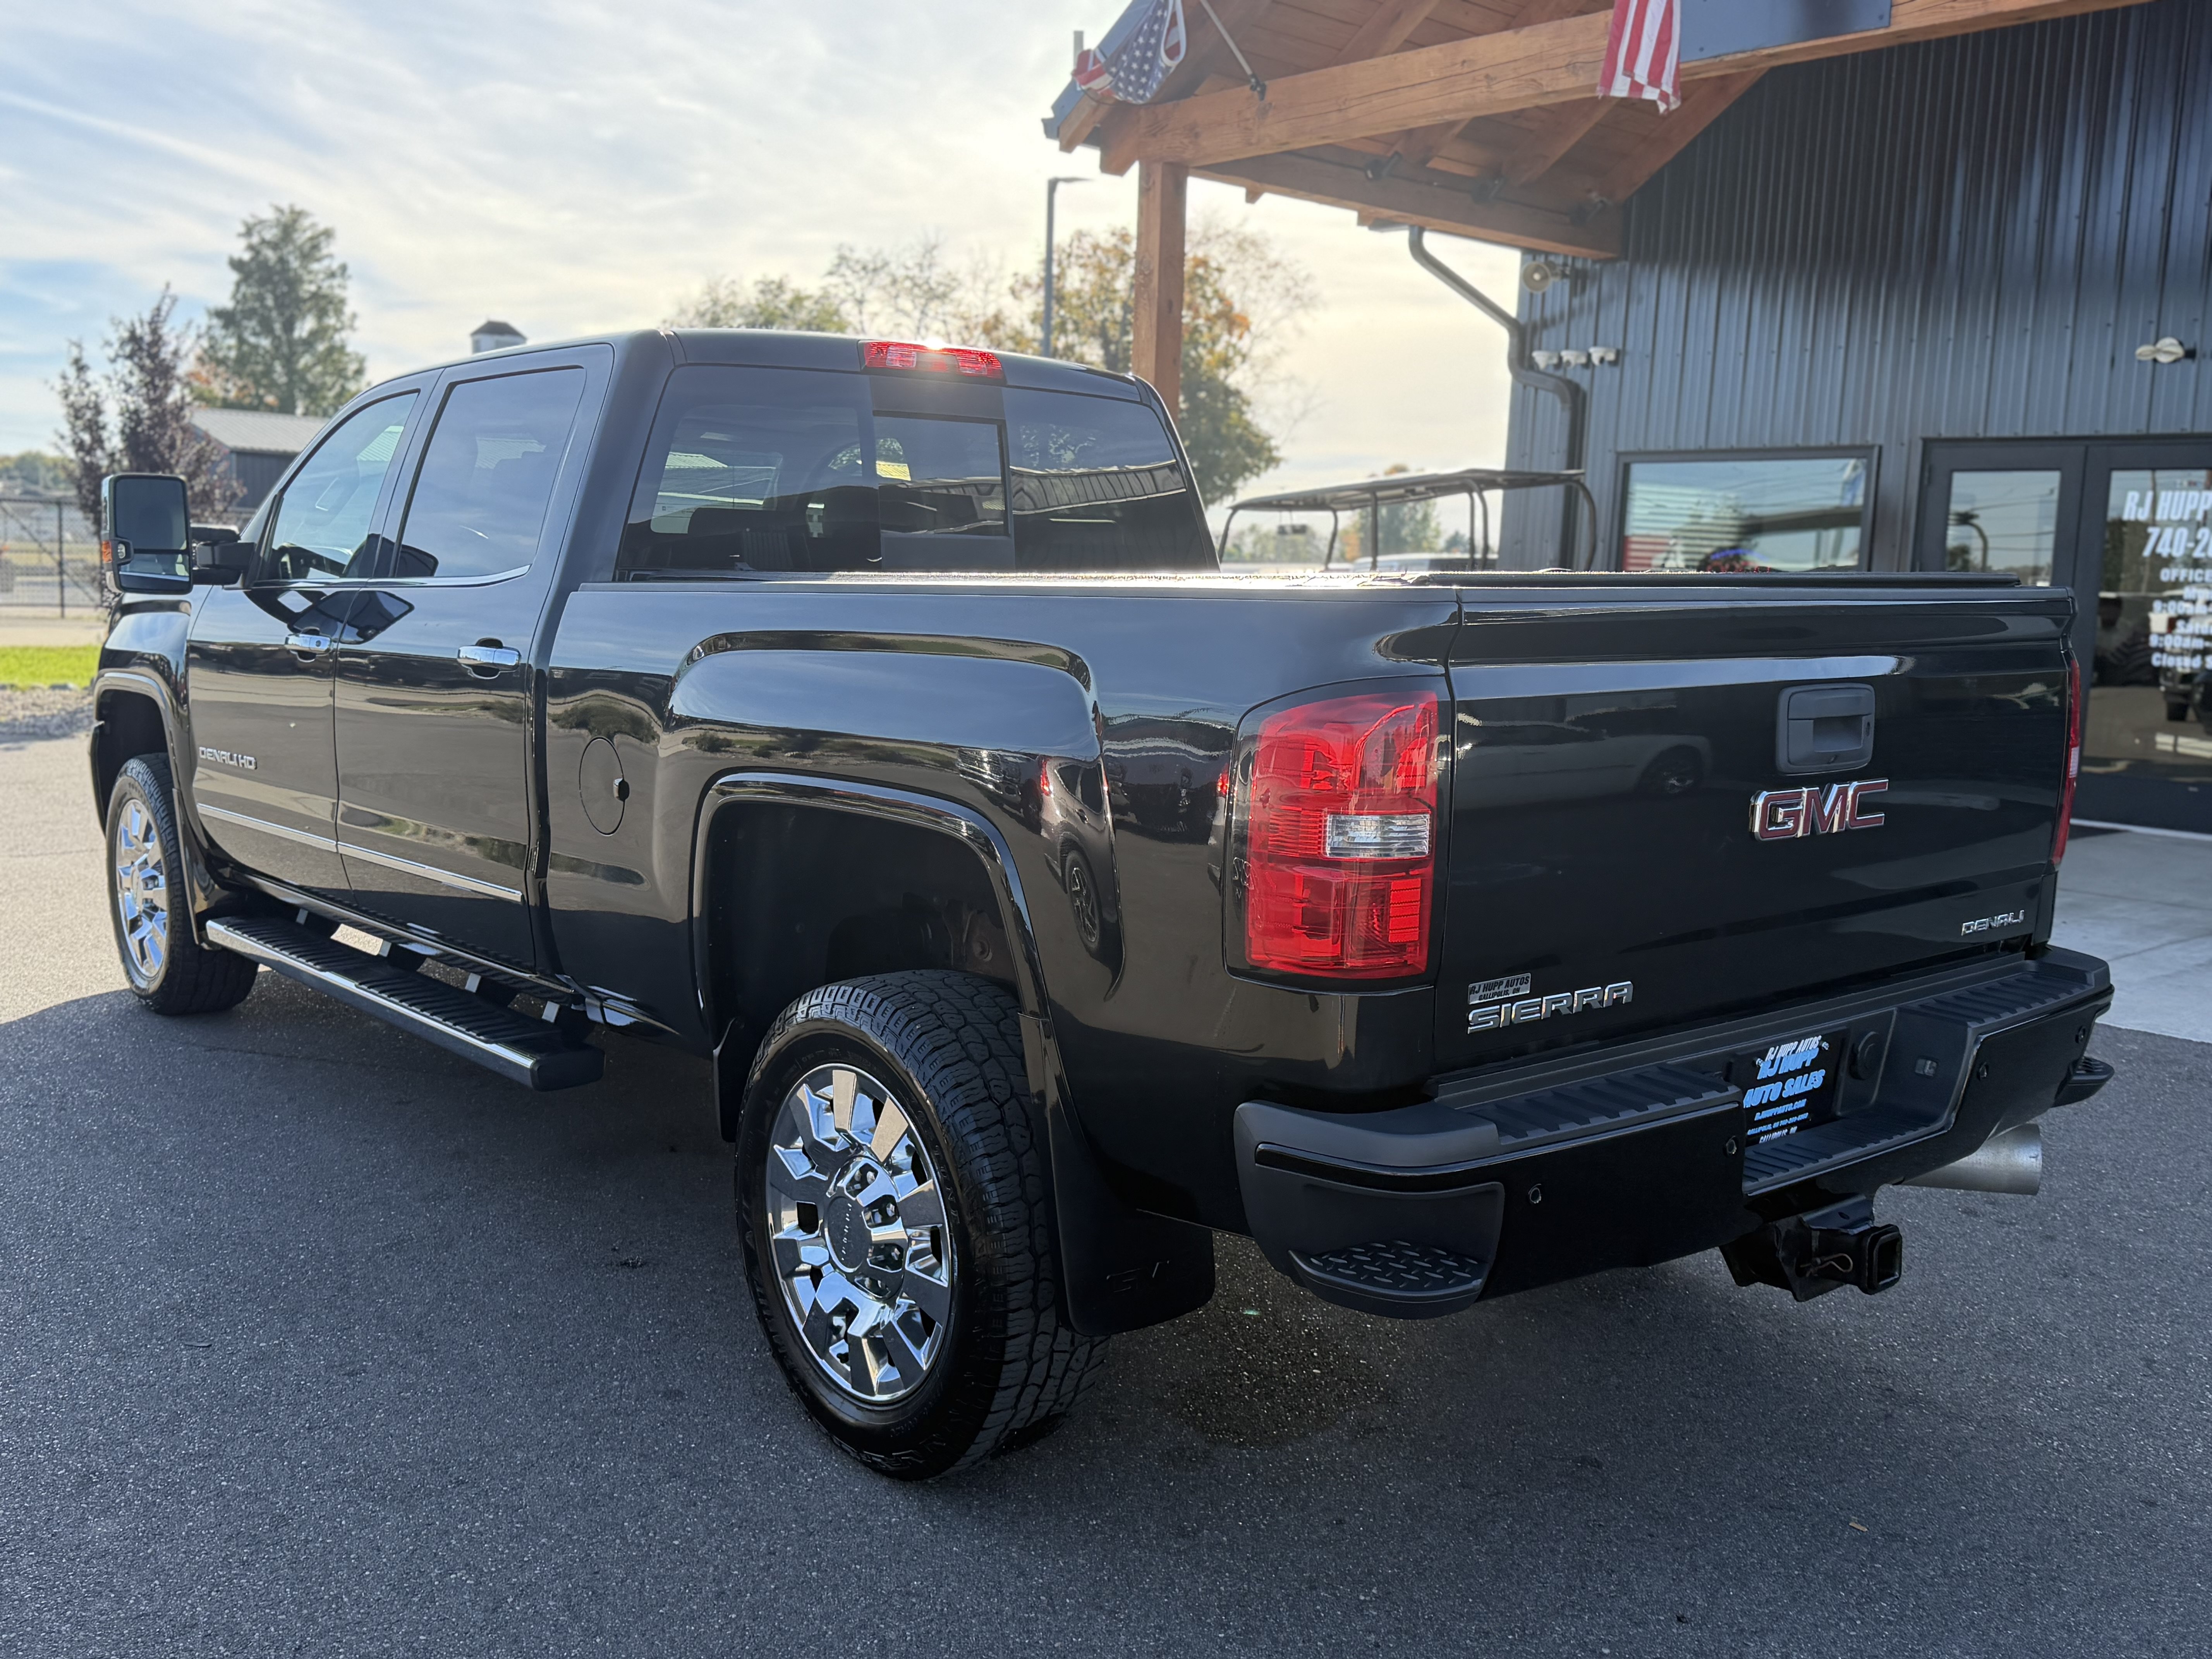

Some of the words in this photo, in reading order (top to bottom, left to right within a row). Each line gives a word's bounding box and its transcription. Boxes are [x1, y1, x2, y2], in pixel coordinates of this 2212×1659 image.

[2122, 490, 2154, 522] RJ
[2155, 490, 2212, 522] HUPP
[199, 747, 238, 767] DENALI
[238, 754, 257, 770] HD
[1749, 777, 1889, 842] GMC
[1961, 909, 2025, 936] DENALI
[1470, 984, 1481, 995] RJ
[1482, 981, 1504, 993] HUPP
[1504, 975, 1530, 989] AUTOS
[1467, 981, 1633, 1034] SIERRA
[1757, 1056, 1781, 1080] RJ
[1778, 1047, 1819, 1074] HUPP
[1765, 1046, 1779, 1062] RJ
[1776, 1041, 1798, 1059] HUPP
[1795, 1035, 1822, 1054] AUTOS
[1743, 1081, 1783, 1109] AUTO
[1782, 1069, 1826, 1098] SALES
